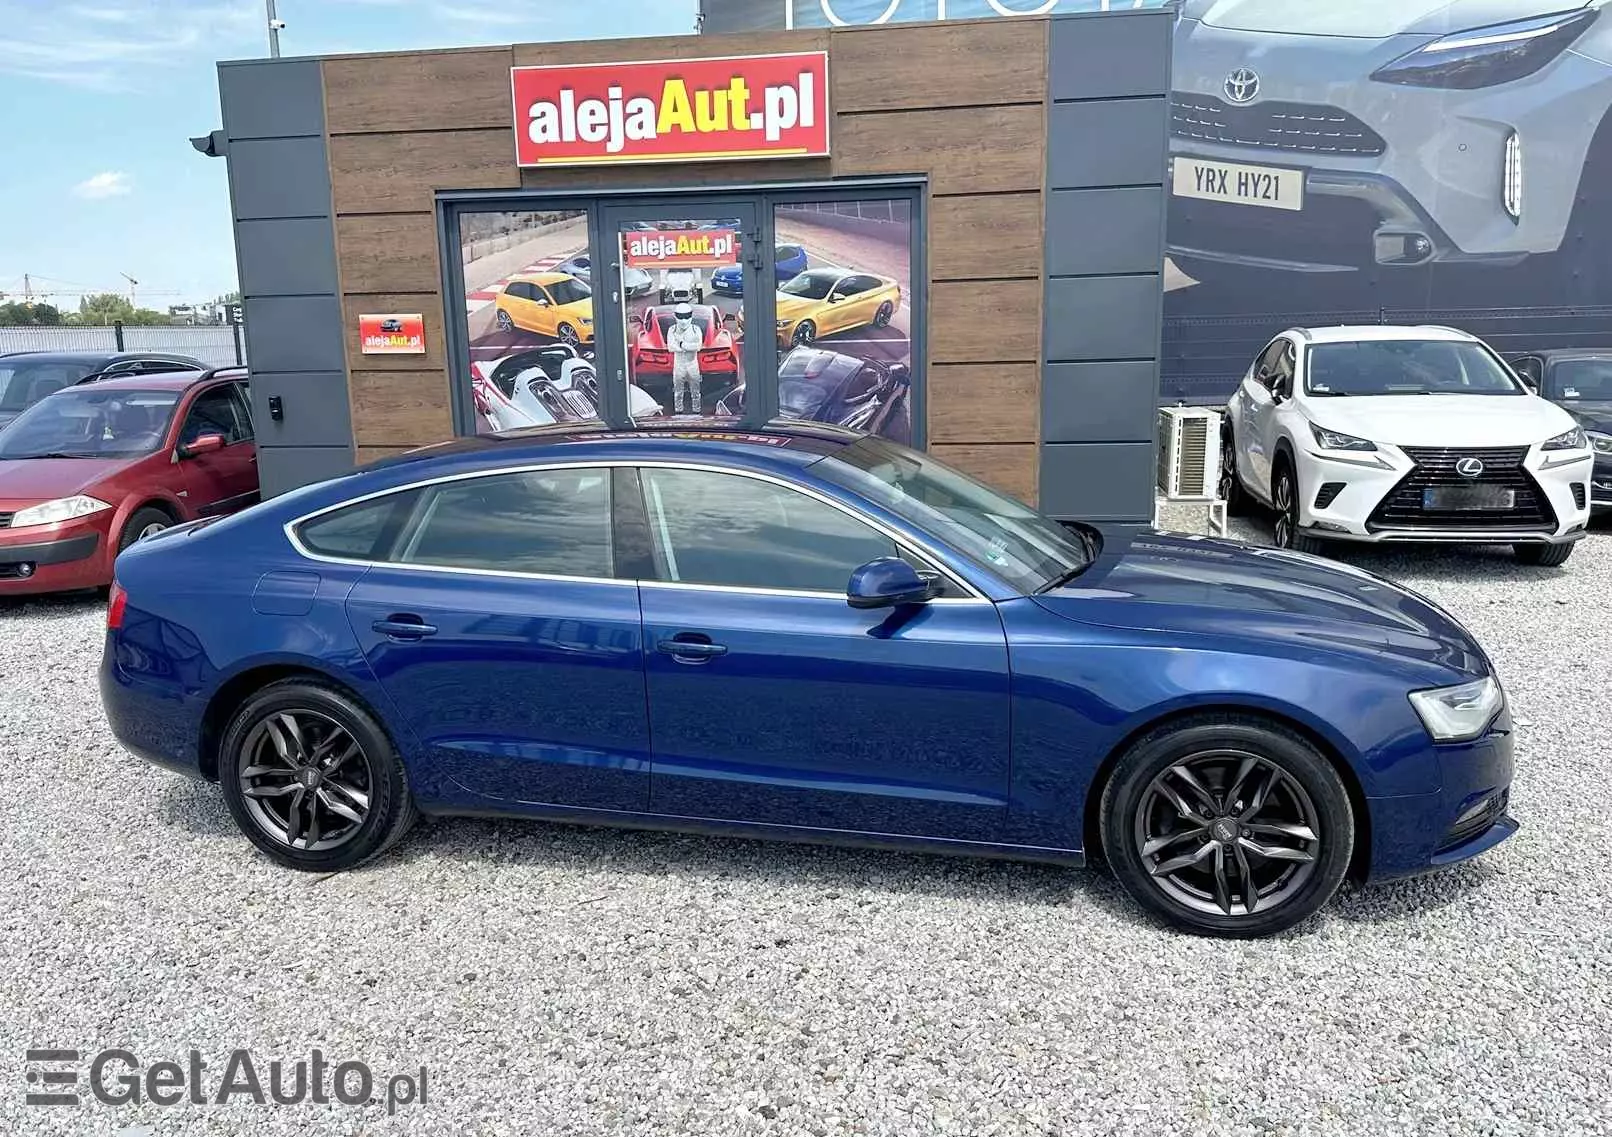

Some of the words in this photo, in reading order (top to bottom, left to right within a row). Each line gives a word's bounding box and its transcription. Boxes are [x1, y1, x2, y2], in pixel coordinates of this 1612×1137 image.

[528, 72, 814, 152] alejaAut.pl
[1194, 166, 1228, 194] YRX
[1237, 171, 1280, 201] HY21
[630, 233, 733, 260] alejaAut.pl
[365, 334, 421, 348] alejaAut.pl
